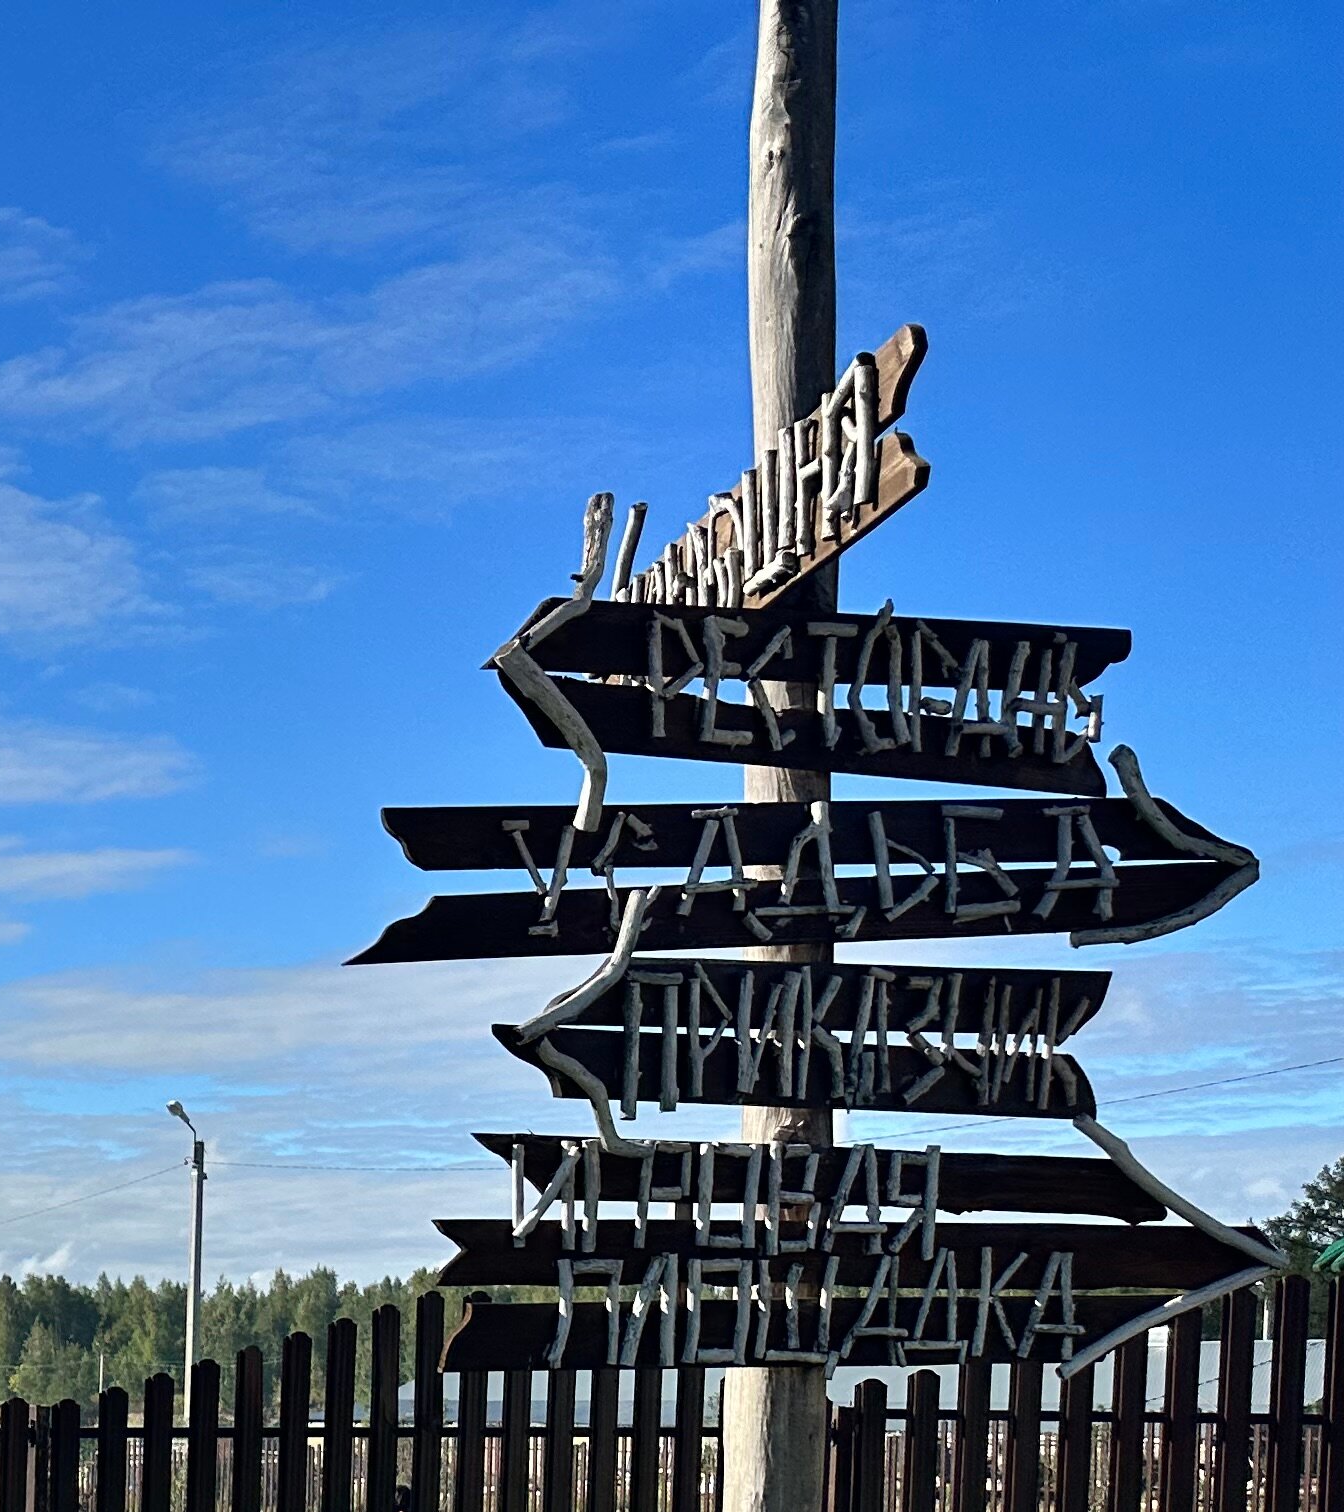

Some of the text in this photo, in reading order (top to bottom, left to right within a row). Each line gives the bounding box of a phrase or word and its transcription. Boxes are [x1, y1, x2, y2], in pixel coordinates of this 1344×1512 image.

[501, 800, 1120, 941] УСАДЬБА
[619, 962, 1091, 1120] ПРИКАЗЧИК
[511, 1138, 941, 1260] ИГРОВАЯ
[543, 1246, 1086, 1379] ПЛОЩАДКА
